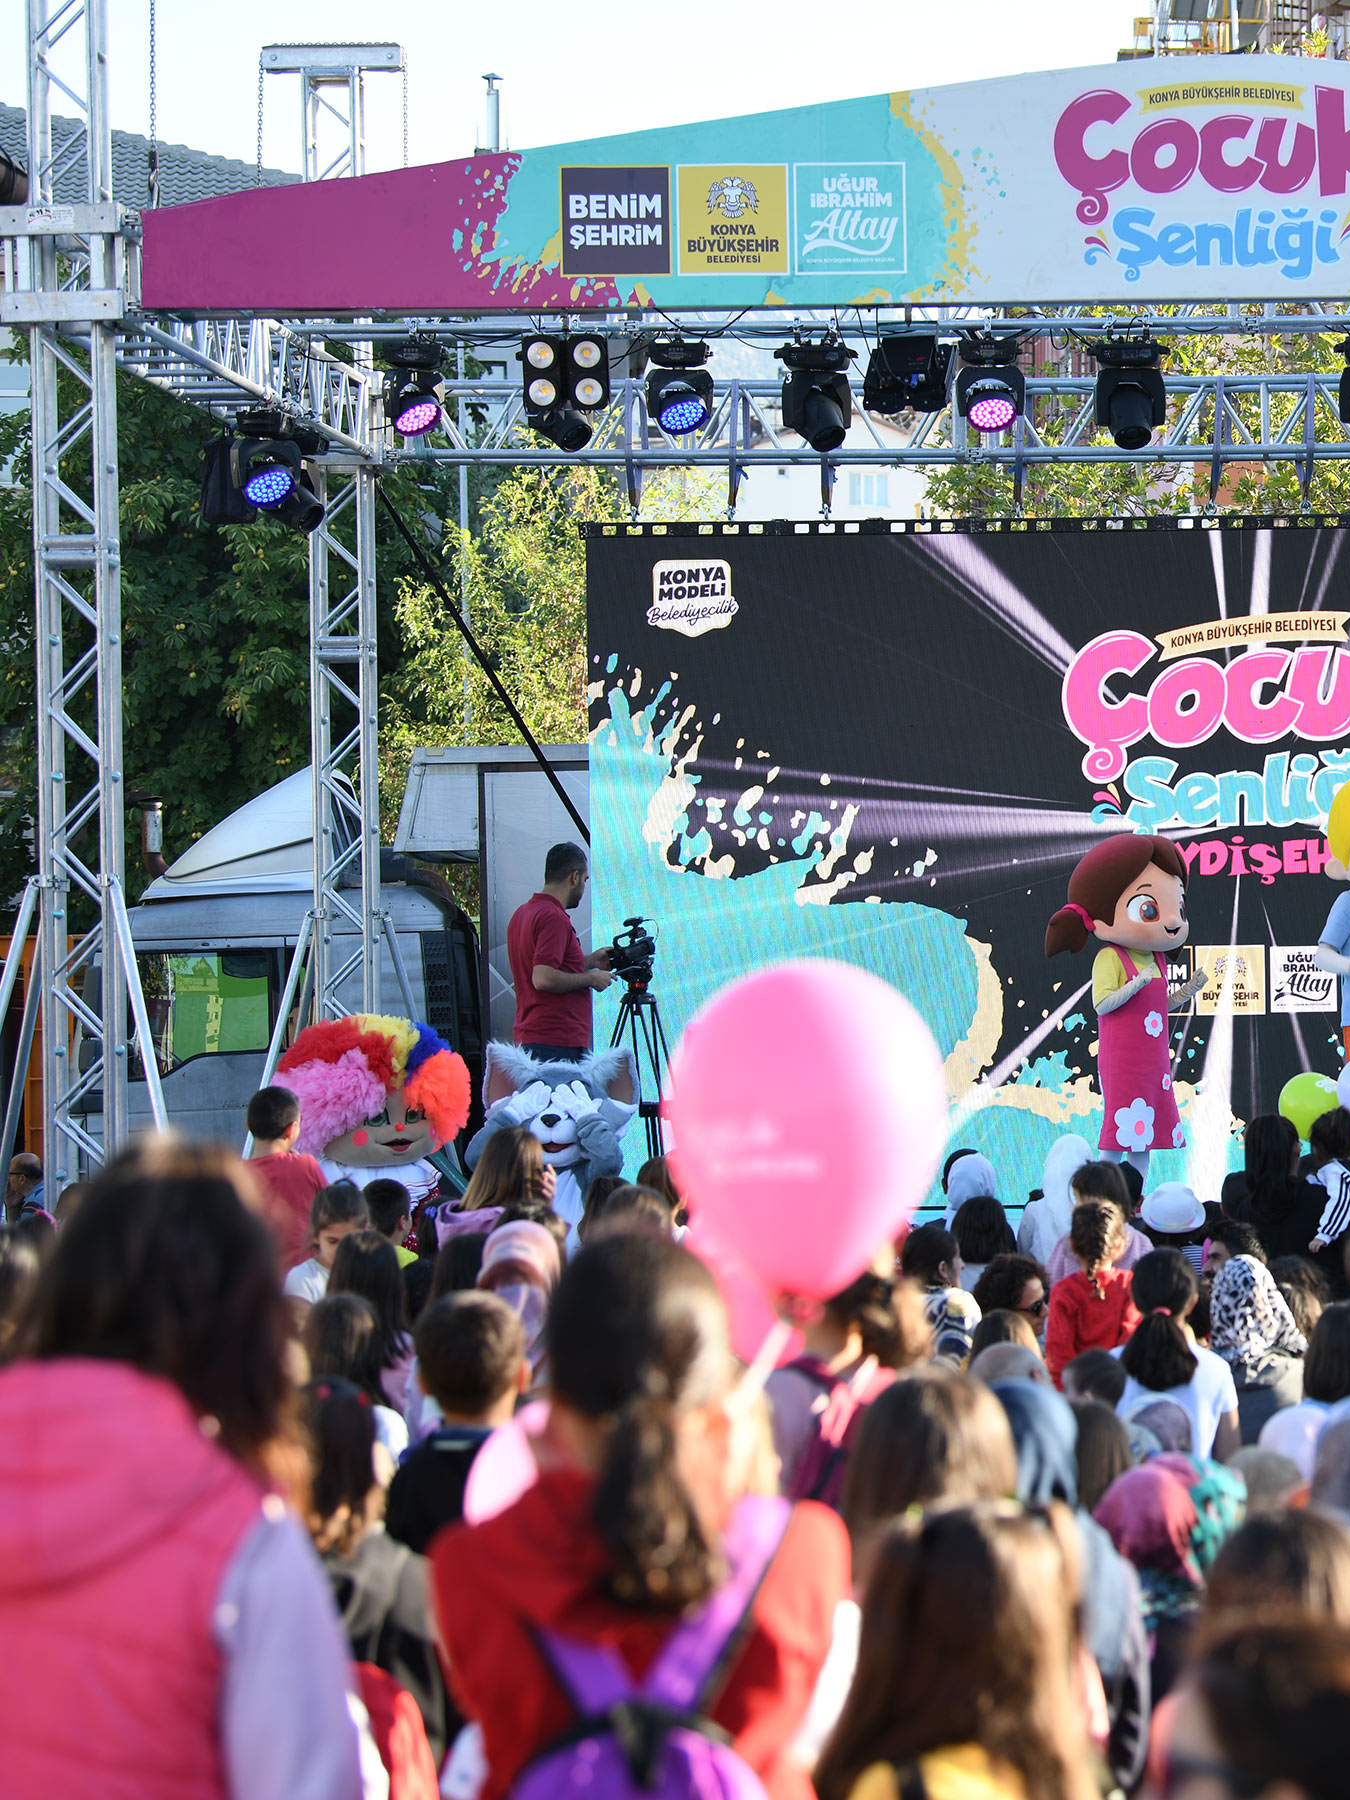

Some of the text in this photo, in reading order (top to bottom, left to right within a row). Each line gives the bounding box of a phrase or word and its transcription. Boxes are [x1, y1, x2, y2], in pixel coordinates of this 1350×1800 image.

[1149, 86, 1295, 104] KONYA BÜYÜKŞEHİR BELEDİYESİ
[822, 173, 878, 193] UĞUR
[710, 223, 756, 236] KONYA
[803, 208, 899, 256] Altay
[687, 235, 780, 254] BÜYÜKŞEHİR
[1113, 207, 1341, 282] Şenliği
[706, 252, 761, 264] BELEDİYESİ
[659, 566, 726, 586] KONYA
[648, 598, 738, 626] Belediyecilik
[1171, 616, 1337, 648] KONYA BÜYÜKŞEHİR BELEDİYESİ
[1287, 951, 1316, 963] UĞU
[1274, 973, 1333, 1001] Altay
